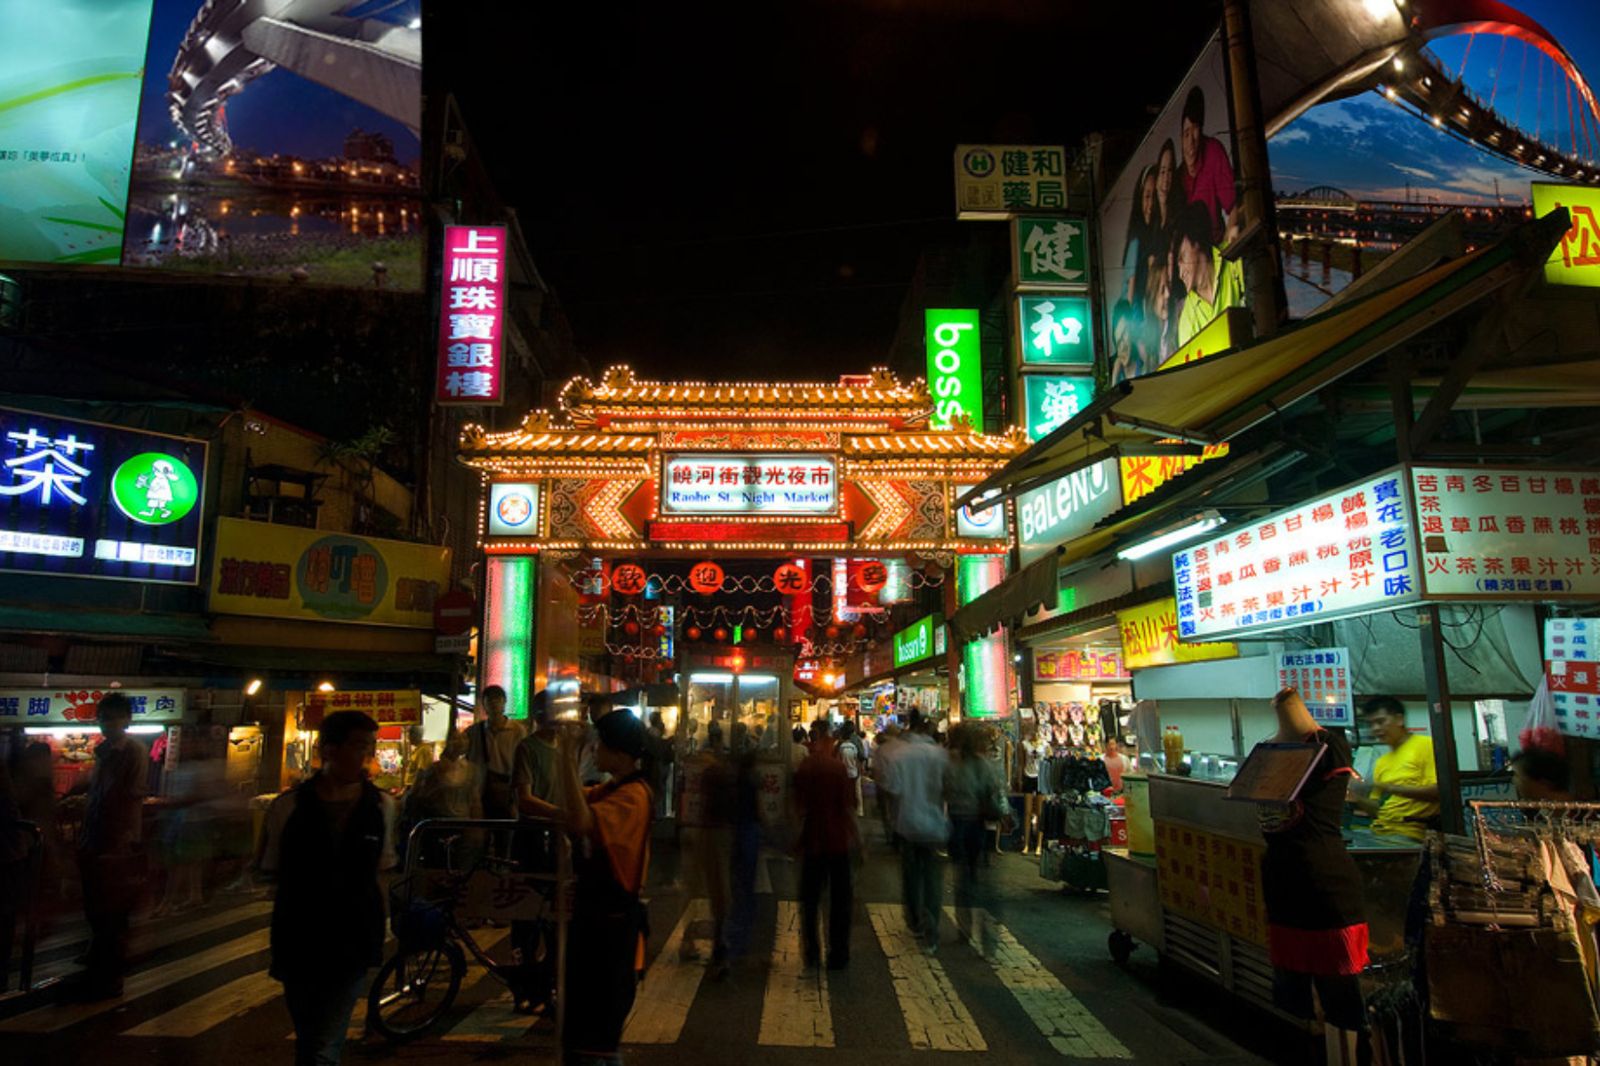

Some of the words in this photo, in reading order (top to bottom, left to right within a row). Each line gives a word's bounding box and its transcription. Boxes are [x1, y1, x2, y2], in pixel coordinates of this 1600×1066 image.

[1001, 150, 1061, 177] 健和
[1003, 181, 1064, 208] 藥局
[446, 230, 498, 397] 上順珠寶銀樓
[934, 322, 974, 431] boss
[0, 428, 94, 505] 茶
[672, 465, 831, 486] 饒河街觀光夜市
[672, 492, 710, 503] Raohe
[743, 492, 775, 506] Night
[784, 492, 829, 503] Market
[1372, 478, 1413, 597] 實在老口味
[1416, 474, 1450, 575] 苦茶退火
[1193, 545, 1216, 622] 苦茶退火
